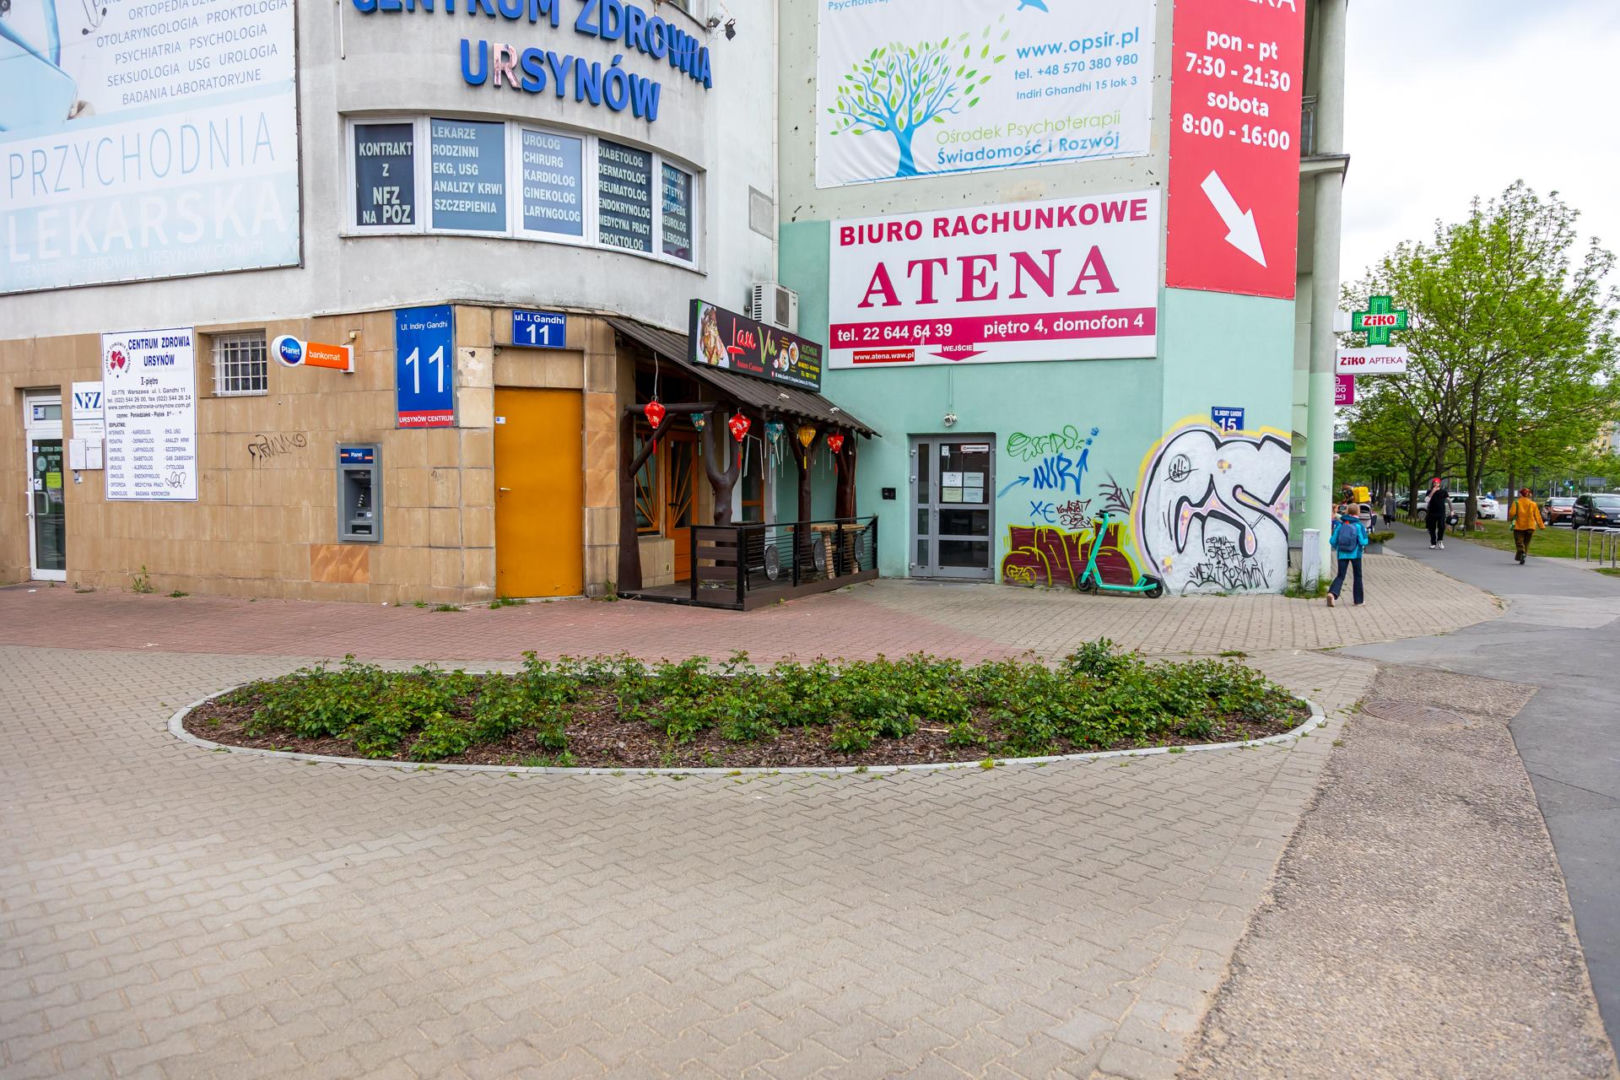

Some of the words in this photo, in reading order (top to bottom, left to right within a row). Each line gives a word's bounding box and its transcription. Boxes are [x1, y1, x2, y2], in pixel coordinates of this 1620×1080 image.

[97, 16, 200, 48] OTOLARYNGOLOGIA
[206, 0, 289, 24] PROKTOLOGIA
[114, 40, 183, 65] PSYCHIATRIA
[189, 23, 268, 50] PSYCHOLOGIA
[574, 0, 713, 89] ZDROWIA
[1016, 26, 1140, 60] www.opsir.pl
[1206, 30, 1242, 52] pon
[1259, 40, 1278, 61] pt
[107, 63, 181, 88] SEKSUOLOGIA
[187, 55, 211, 73] USG
[218, 43, 279, 67] UROLOGIA
[1014, 67, 1034, 81] tel.
[1037, 63, 1060, 77] +48
[1063, 60, 1086, 75] 570
[1088, 57, 1112, 71] 380
[1115, 53, 1138, 67] 980
[1185, 52, 1226, 79] 7:30
[1242, 64, 1291, 92] 21:30
[121, 86, 169, 106] BADANIA
[169, 68, 262, 98] LABORATORYJNE
[460, 38, 662, 123] URSYNÓW
[1044, 82, 1092, 97] Ghandhi
[1095, 79, 1108, 90] 15
[1110, 77, 1128, 89] lok
[1130, 75, 1138, 86] 3
[1206, 90, 1269, 118] sobota
[432, 126, 477, 140] LEKARZE
[936, 126, 1004, 146] Ośrodek
[1006, 109, 1122, 139] Psychoterapii
[1181, 113, 1224, 139] 8:00
[1240, 124, 1291, 151] 16:00
[358, 141, 413, 157] KONTRAKT
[432, 144, 480, 159] RODZINNI
[523, 133, 561, 151] UROLOG
[937, 140, 1043, 165] Świadomość
[1058, 131, 1120, 153] Rozwój
[8, 111, 276, 200] PRZYCHODNIA
[523, 151, 565, 169] CHIRURG
[598, 146, 644, 168] DIABETOLOG
[382, 163, 389, 177] Z
[433, 162, 456, 177] EKG,
[458, 163, 479, 176] USG
[523, 169, 576, 188] KARDIOLOG
[598, 163, 647, 185] DERMATOLOG
[372, 186, 400, 204] NFZ
[433, 180, 475, 194] ANALIZY
[477, 182, 503, 195] KRWI
[523, 186, 576, 205] GINEKOLOG
[598, 180, 647, 202] REUMATOLOG
[362, 209, 377, 224] NA
[382, 204, 412, 224] POZ
[434, 198, 498, 214] SZCZEPIENIA
[523, 204, 581, 222] LARYNGOLOG
[599, 197, 651, 219] ENDOKRYNOLOG
[8, 180, 288, 264] LEKARSKA
[632, 221, 651, 235] PRACY
[840, 219, 923, 247] BIURO
[932, 198, 1149, 239] RACHUNKOWE
[599, 231, 645, 251] PROKTOLOG
[856, 244, 1120, 309] ATENA
[410, 321, 425, 331] Indiry
[426, 320, 448, 330] Gandhi
[514, 314, 526, 322] ul.
[533, 314, 565, 325] Gandhi
[983, 319, 1030, 338] piętro
[1033, 319, 1049, 335] 4,
[1052, 316, 1129, 333] domofon
[1132, 313, 1145, 328] 4
[128, 337, 158, 350] CENTRUM
[161, 335, 191, 349] ZDROWIA
[525, 323, 550, 345] 11
[837, 330, 859, 343] tel.
[863, 328, 881, 341] 22
[883, 326, 909, 340] 644
[912, 325, 932, 339] 64
[934, 323, 953, 338] 39
[308, 350, 341, 362] bankomat
[854, 350, 915, 363] www.atena.waw.pl
[942, 342, 974, 353] WEJŚCIE
[143, 352, 175, 367] URSYNÓW
[405, 344, 444, 395] 11
[1368, 356, 1403, 365] APTEKA
[74, 391, 102, 409] NFZ
[399, 414, 427, 423] URSYNÓW
[427, 414, 455, 423] CENTRUM
[1218, 417, 1237, 432] 15
